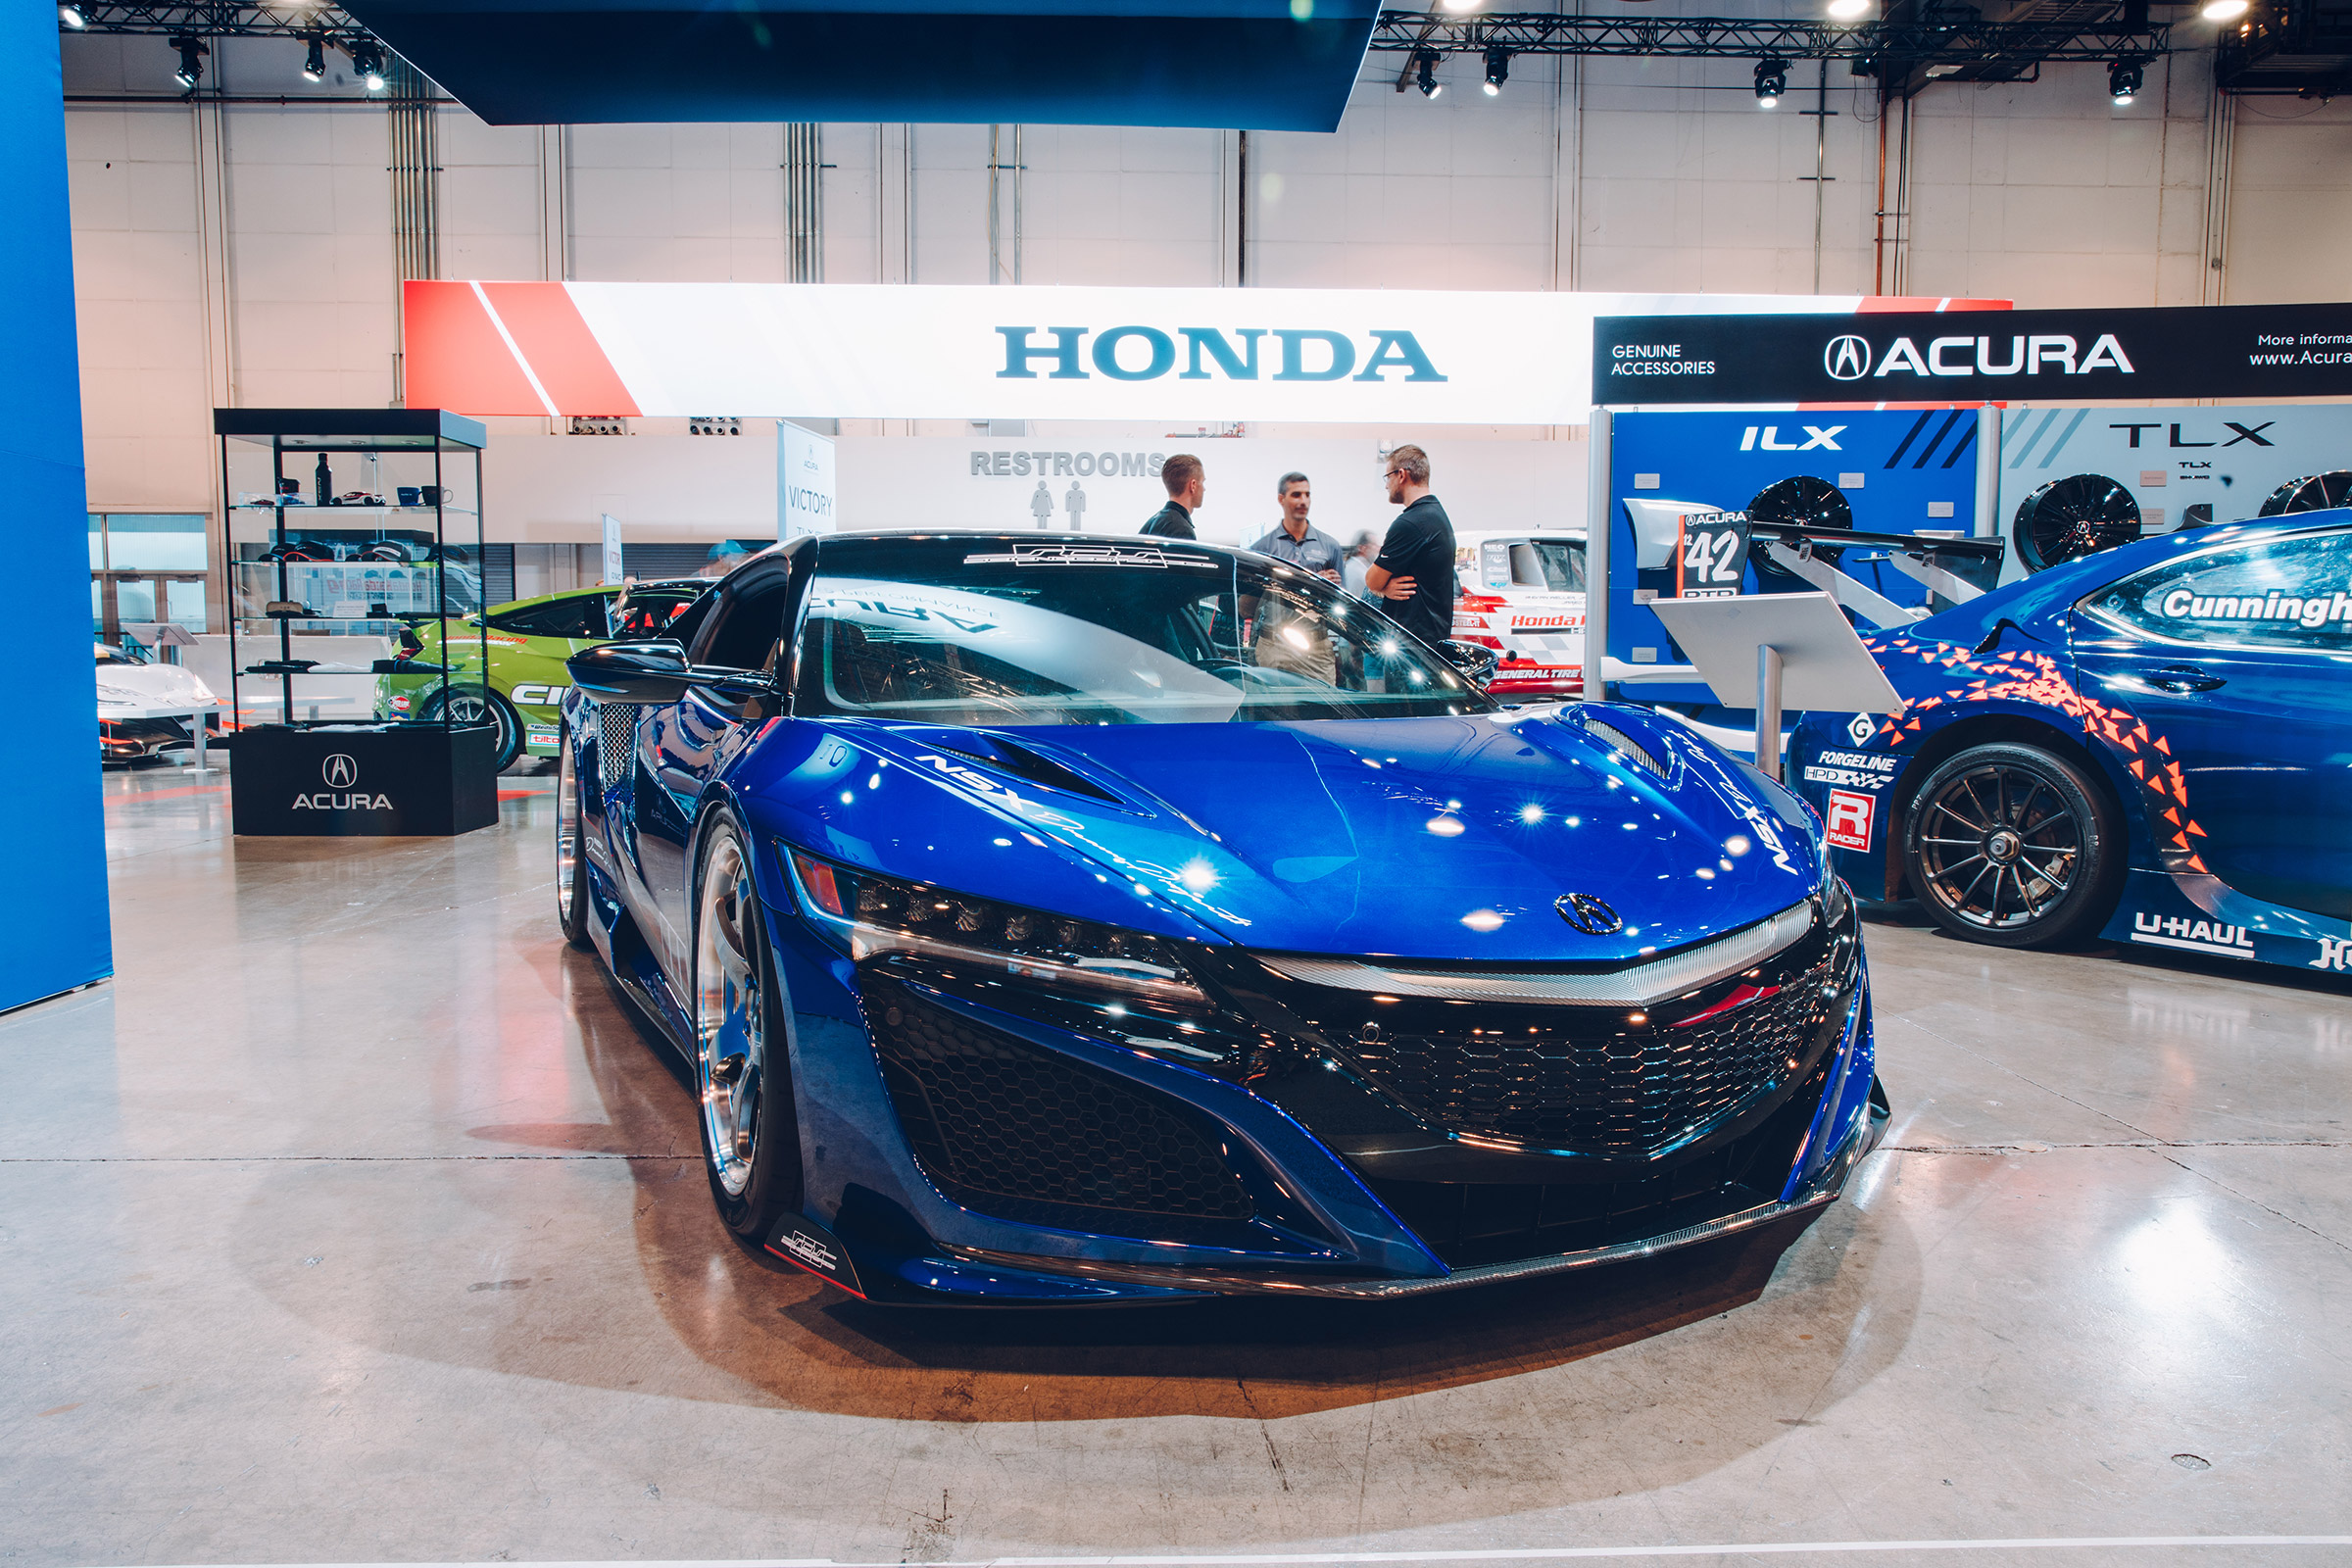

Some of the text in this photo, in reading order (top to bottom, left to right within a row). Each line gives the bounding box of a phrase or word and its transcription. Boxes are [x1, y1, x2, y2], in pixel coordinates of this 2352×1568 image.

[1612, 344, 1682, 359] GENUINE
[2257, 334, 2294, 346] More
[995, 324, 1448, 383] HONDA
[1873, 333, 2135, 377] ACURA
[2249, 350, 2352, 366] www.Acura
[1611, 361, 1716, 376] ACCESSORIES
[1740, 424, 1848, 451] ILX
[2109, 421, 2277, 449] TLX
[970, 451, 1165, 477] RESTROOMS
[789, 485, 833, 517] VICTORY
[1695, 511, 1747, 525] ACURA
[1684, 529, 1740, 583] 42
[2164, 590, 2352, 627] Cunningh
[1511, 615, 1577, 626] Honda
[1494, 669, 1581, 680] GENERAL TIRE
[1853, 719, 1869, 739] G
[1818, 751, 1897, 772] FORGELINE
[914, 754, 1043, 812] NSX
[1805, 767, 1839, 781] HPD
[292, 793, 394, 809] ACURA
[1830, 795, 1870, 836] R
[1735, 799, 1799, 876] NSX
[1829, 832, 1866, 847] RACER
[2134, 911, 2254, 948] U-HAUL
